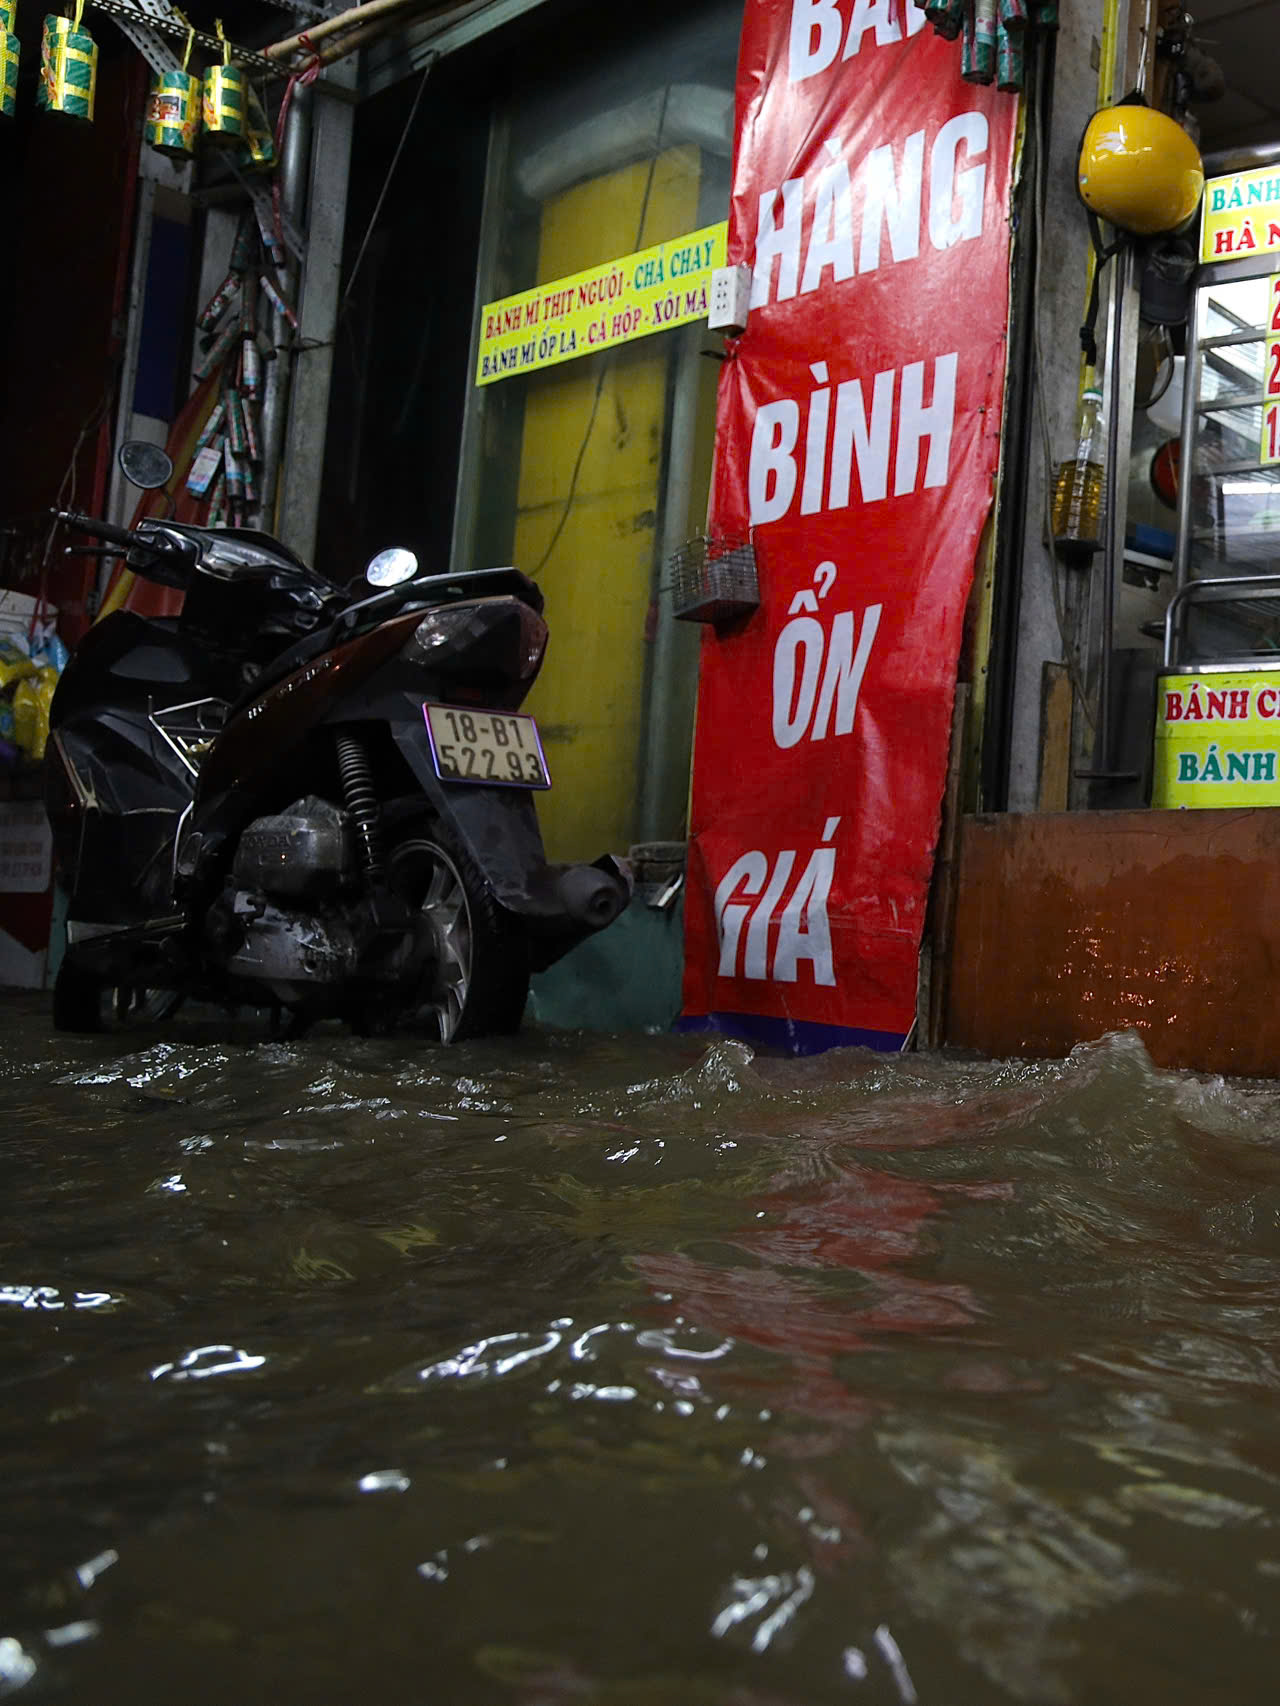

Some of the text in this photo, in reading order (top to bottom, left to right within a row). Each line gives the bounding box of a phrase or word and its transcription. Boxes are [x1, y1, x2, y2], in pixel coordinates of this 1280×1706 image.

[750, 110, 988, 310] HÀNG
[1211, 178, 1280, 211] BÁNH
[1214, 220, 1256, 254] HÀ
[485, 304, 522, 339] BÁNH
[543, 289, 575, 322] THỊT
[577, 266, 624, 310] NGUỘI
[670, 240, 714, 278] CHAY
[481, 345, 518, 377] BÁNH
[560, 329, 577, 353] LA
[612, 305, 642, 339] HỘP
[651, 291, 681, 325] XÔI
[748, 351, 959, 527] BÌNH
[772, 560, 882, 749] ỔN
[445, 711, 524, 749] 18-B1
[1165, 683, 1249, 721] BÁNH
[1177, 744, 1275, 782] BÁNH
[716, 816, 841, 987] GIÁ
